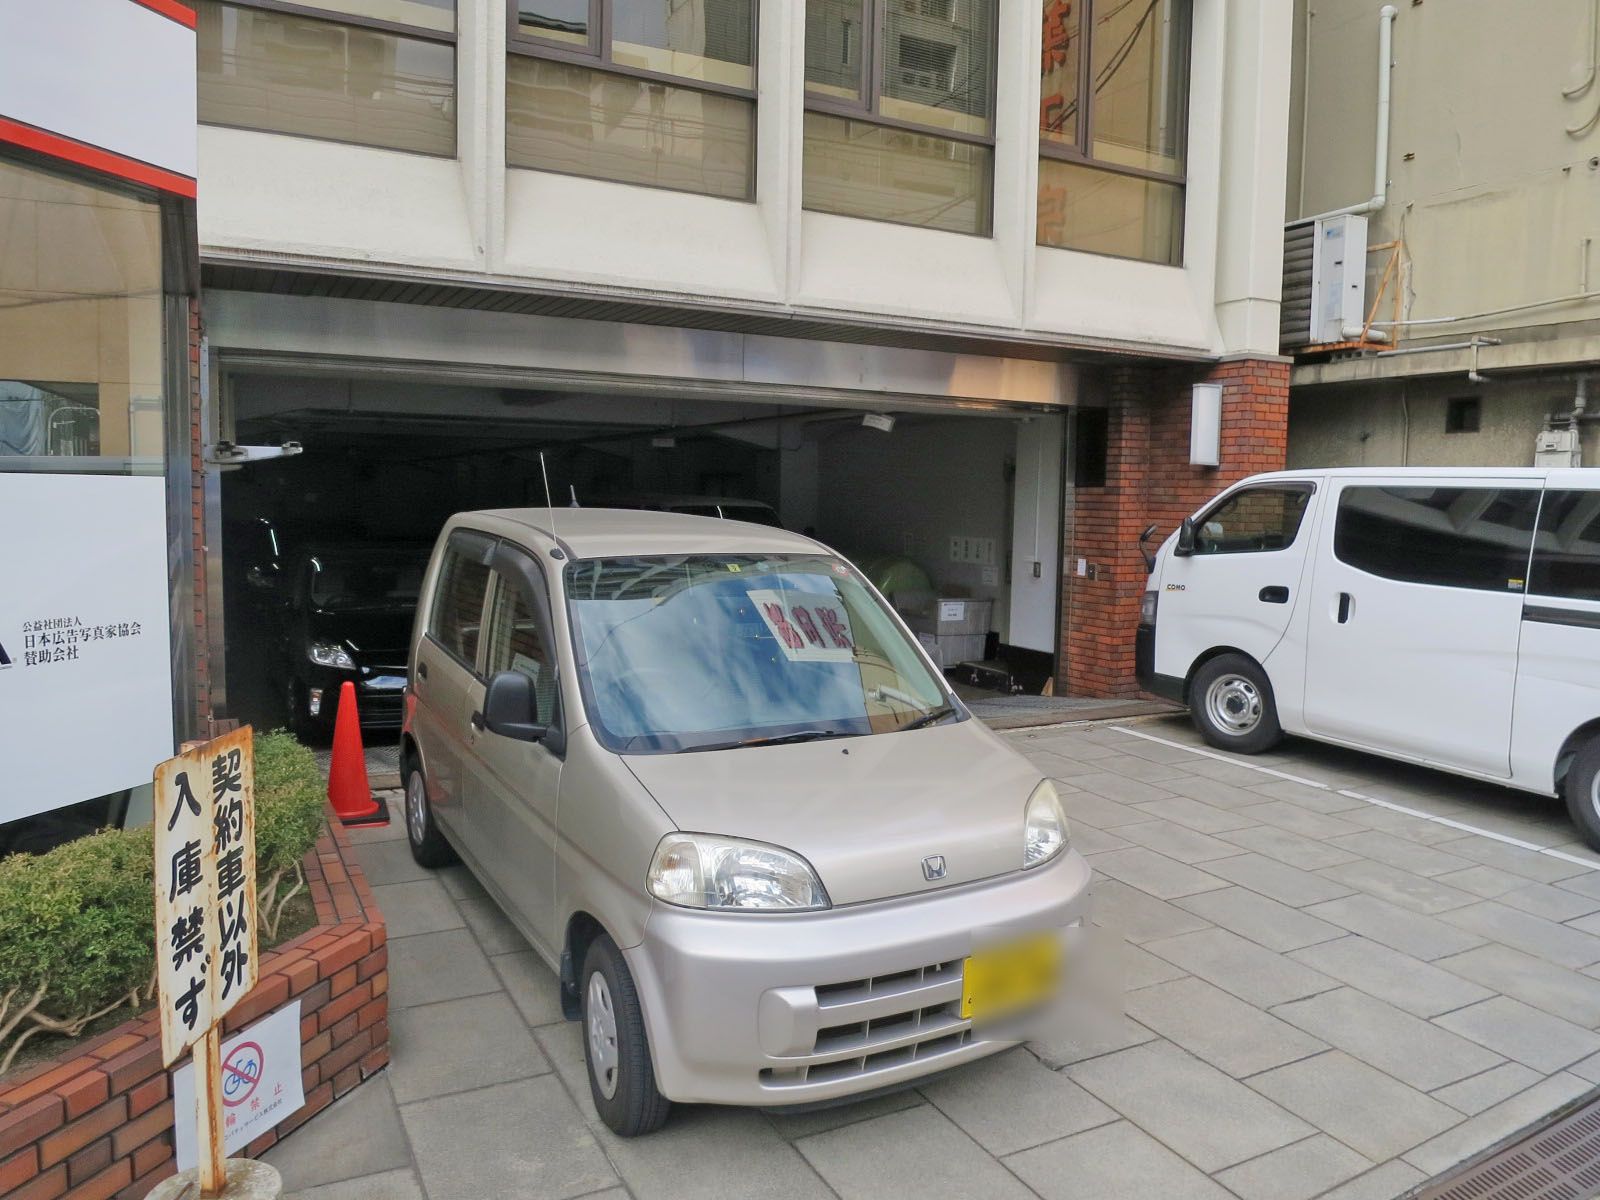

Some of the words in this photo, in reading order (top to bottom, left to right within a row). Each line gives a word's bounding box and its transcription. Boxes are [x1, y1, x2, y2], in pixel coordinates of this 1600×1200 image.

[23, 616, 82, 632] 公益社団法人
[25, 622, 142, 648] 日本広告写真家協会
[25, 645, 79, 666] 賛助会社
[212, 748, 248, 1000] 契約車以外
[168, 772, 211, 1031] 入庫禁ず
